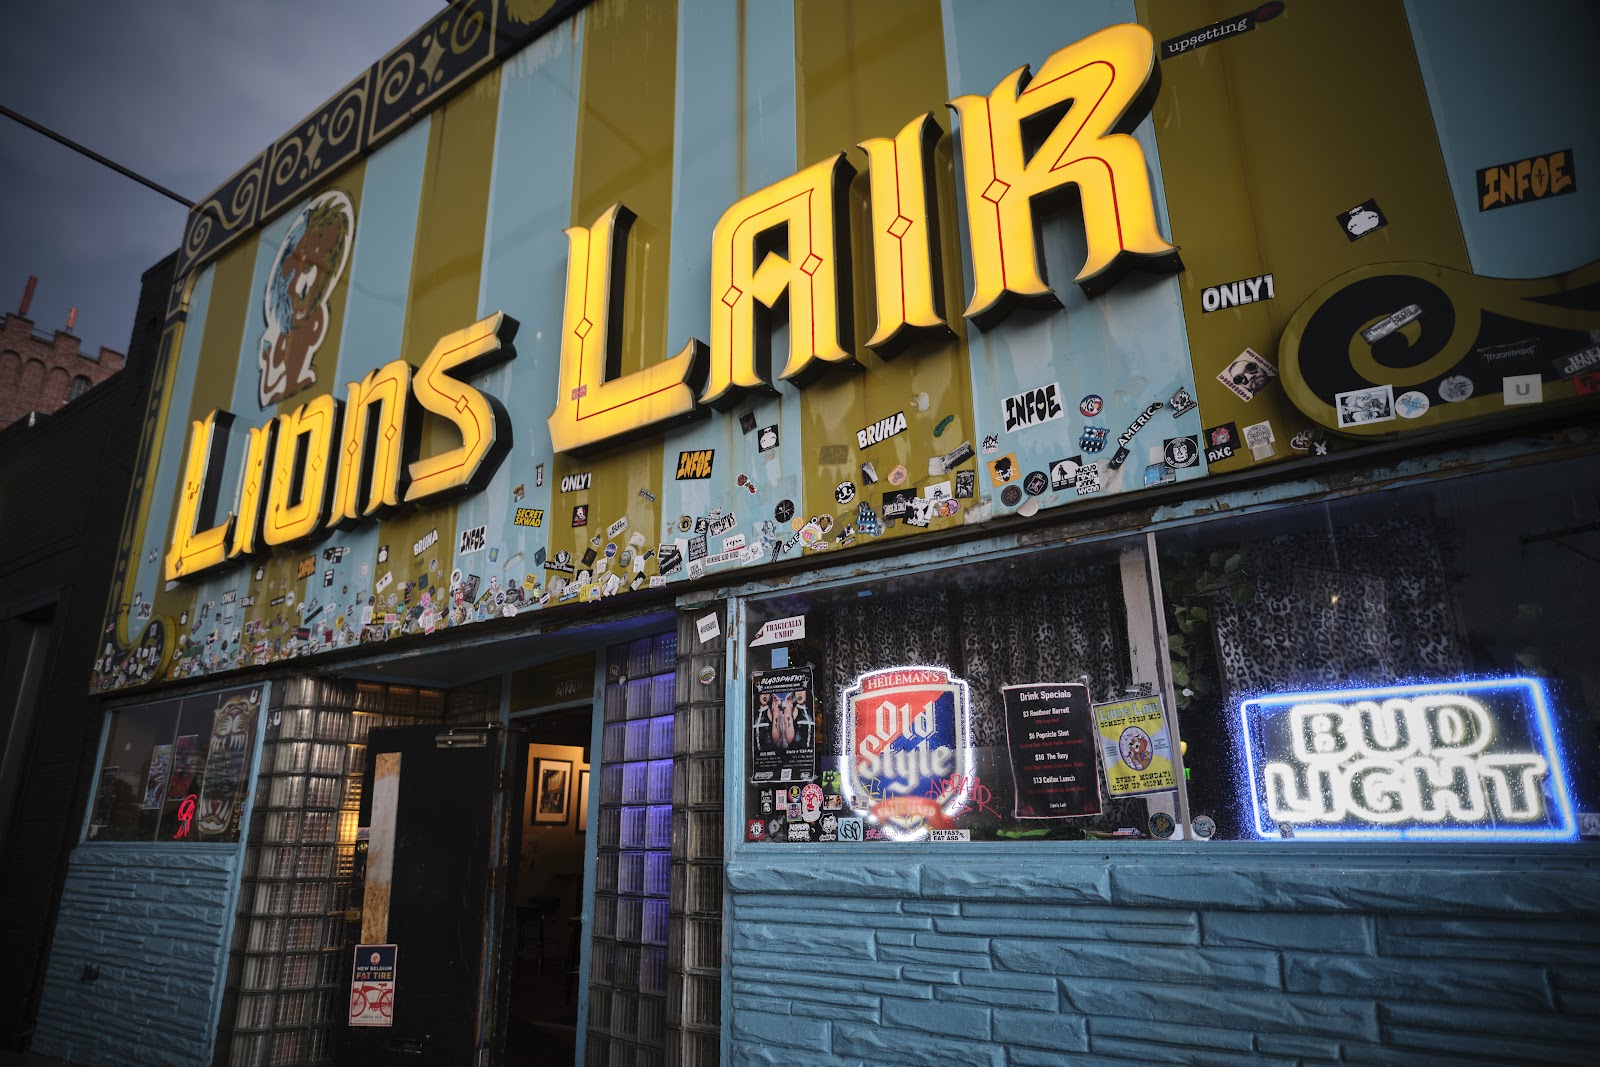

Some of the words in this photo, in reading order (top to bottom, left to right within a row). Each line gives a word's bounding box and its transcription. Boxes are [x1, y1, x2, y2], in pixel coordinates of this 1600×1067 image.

[1168, 16, 1248, 54] upsetting
[1483, 152, 1573, 210] INFOE
[1202, 275, 1274, 312] ONLY1
[1005, 384, 1063, 432] INFOE
[857, 412, 907, 449] BRUHA
[676, 450, 713, 479] INFOE
[561, 472, 592, 492] ONLY1
[514, 517, 541, 527] SKWAD
[516, 509, 543, 519] SECRET
[460, 526, 486, 554] INFOE
[766, 618, 803, 632] TRAGICALLY
[774, 629, 794, 639] UNHIP
[868, 671, 940, 690] HEILEMAN'S
[1020, 690, 1039, 702] Drink
[1040, 689, 1072, 701] Specials
[875, 699, 937, 743] Old
[1022, 710, 1029, 718] $3
[1100, 718, 1126, 728] COMEDY
[1128, 715, 1146, 724] OPEN
[1148, 712, 1162, 721] MIC
[1029, 732, 1035, 740] $6
[1035, 730, 1057, 740] Popsicle
[1057, 729, 1070, 737] Shot
[1290, 694, 1495, 763] BUD
[859, 733, 953, 795] Style
[1046, 752, 1056, 760] The
[1043, 775, 1059, 784] Colfax
[1059, 774, 1076, 783] Lunch
[1112, 783, 1129, 791] SIGN
[1131, 782, 1141, 790] UP
[1115, 775, 1136, 784] EVERY
[1265, 752, 1547, 822] LIGHT
[373, 971, 392, 980] TIRE
